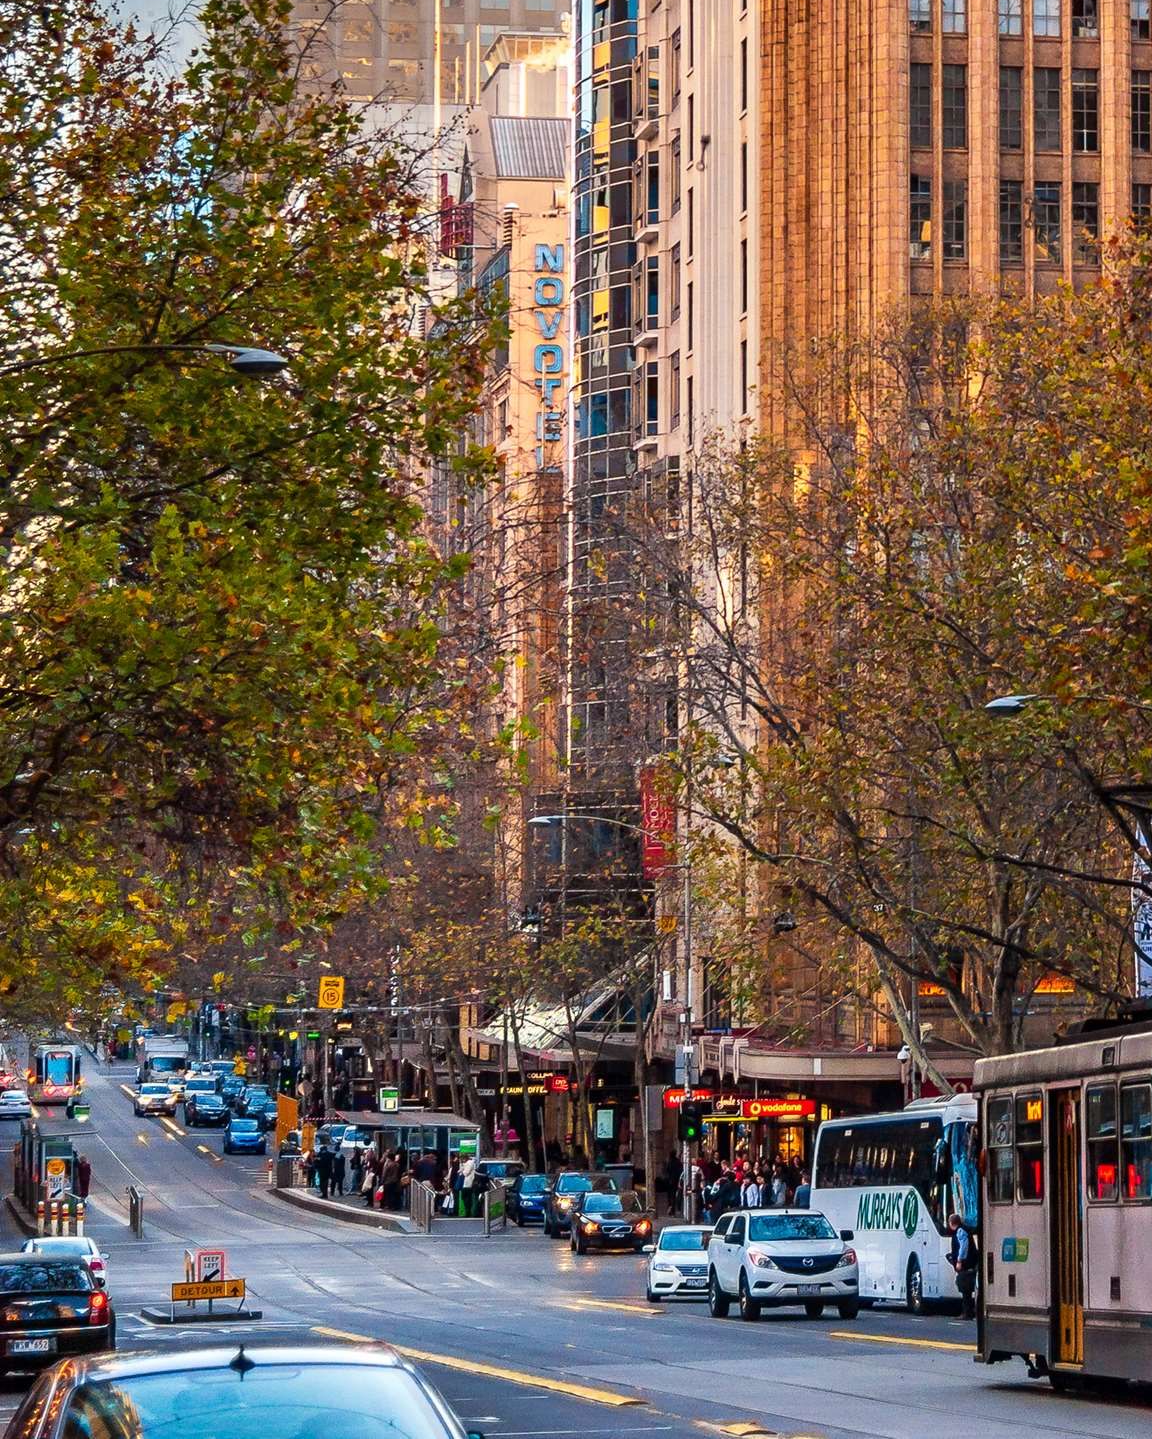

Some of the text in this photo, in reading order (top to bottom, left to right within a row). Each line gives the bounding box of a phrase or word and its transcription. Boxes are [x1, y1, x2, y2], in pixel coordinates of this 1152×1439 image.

[534, 243, 564, 473] NOVOTEL
[326, 992, 336, 1002] 15
[762, 1103, 802, 1113] vodafone
[857, 1192, 902, 1231] MURRAYS
[180, 1285, 223, 1296] DETOUR
